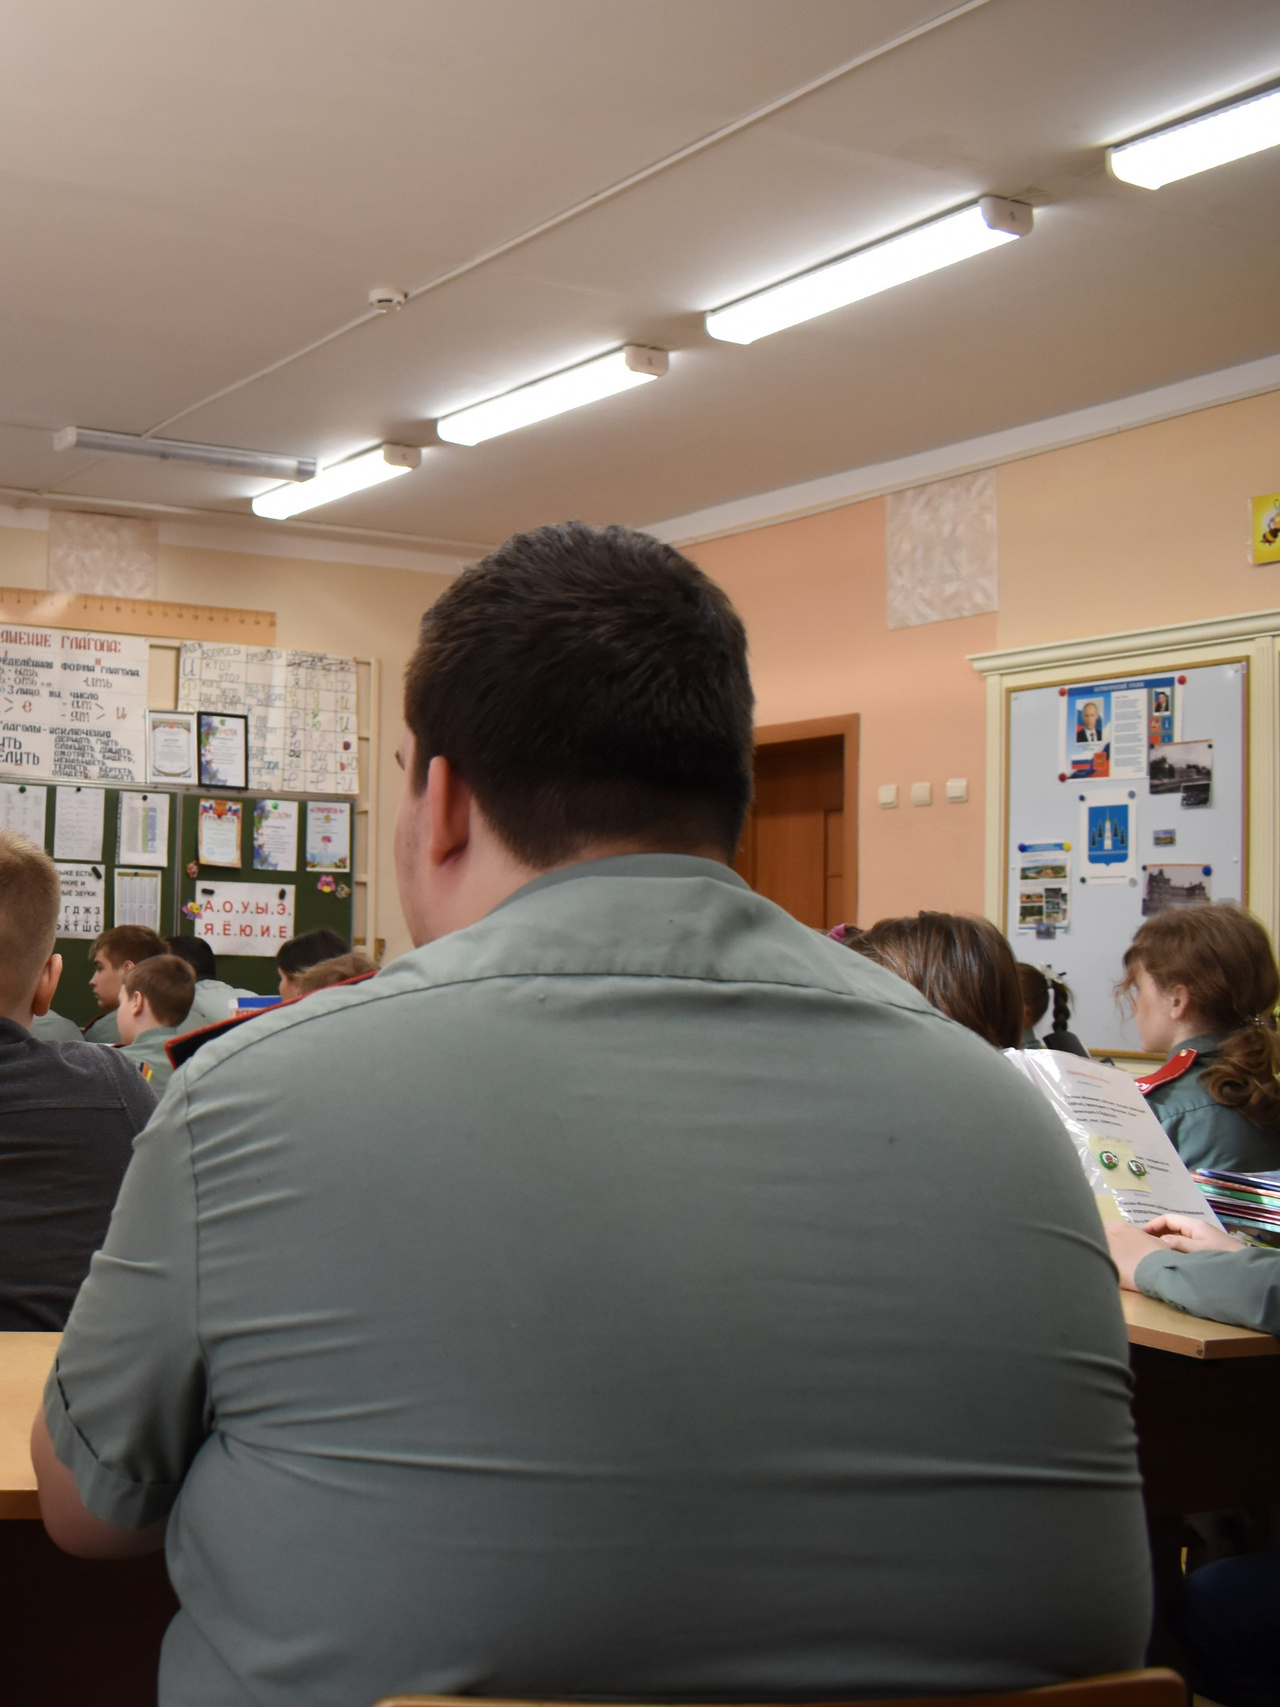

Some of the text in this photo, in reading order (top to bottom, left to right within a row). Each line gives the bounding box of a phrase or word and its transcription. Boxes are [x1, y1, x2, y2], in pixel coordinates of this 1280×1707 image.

[61, 661, 96, 673] ФОРМА
[8, 684, 14, 694] 3
[76, 869, 93, 877] ЕСТЬ
[65, 905, 70, 914] Г
[73, 906, 79, 915] Д
[83, 906, 91, 914] Ж
[83, 924, 91, 932] Ш
[94, 924, 100, 932] С
